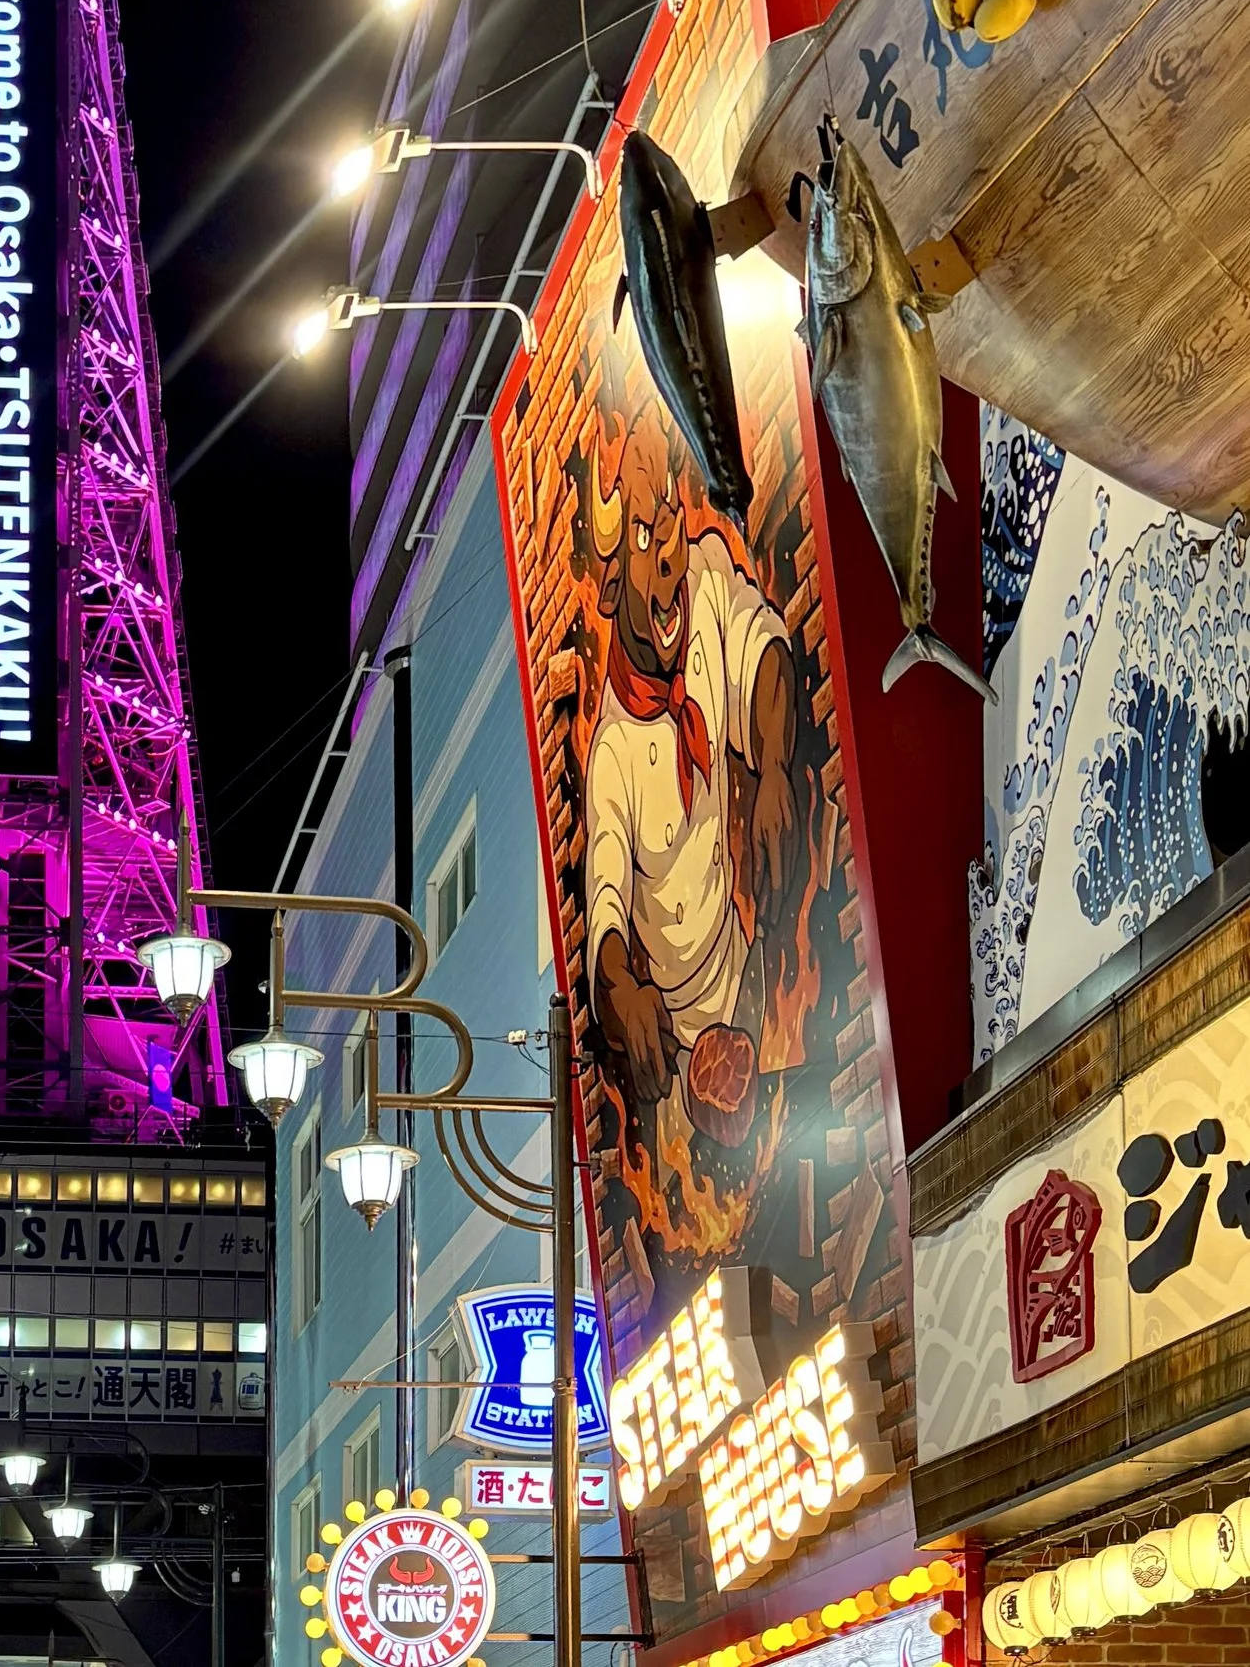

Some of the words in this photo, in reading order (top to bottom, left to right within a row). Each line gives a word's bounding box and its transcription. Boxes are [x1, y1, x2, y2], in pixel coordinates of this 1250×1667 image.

[486, 1307, 597, 1335] LAWSN
[93, 1365, 197, 1409] 通天閣
[610, 1265, 742, 1511] STEAK
[486, 1402, 596, 1428] STATN
[697, 1323, 865, 1593] HOUSE
[477, 1470, 606, 1505] 酒・たこ
[340, 1527, 397, 1597] STEAK
[426, 1524, 483, 1599] HOUSE
[377, 1594, 447, 1624] KING
[374, 1638, 452, 1667] OSAKA
